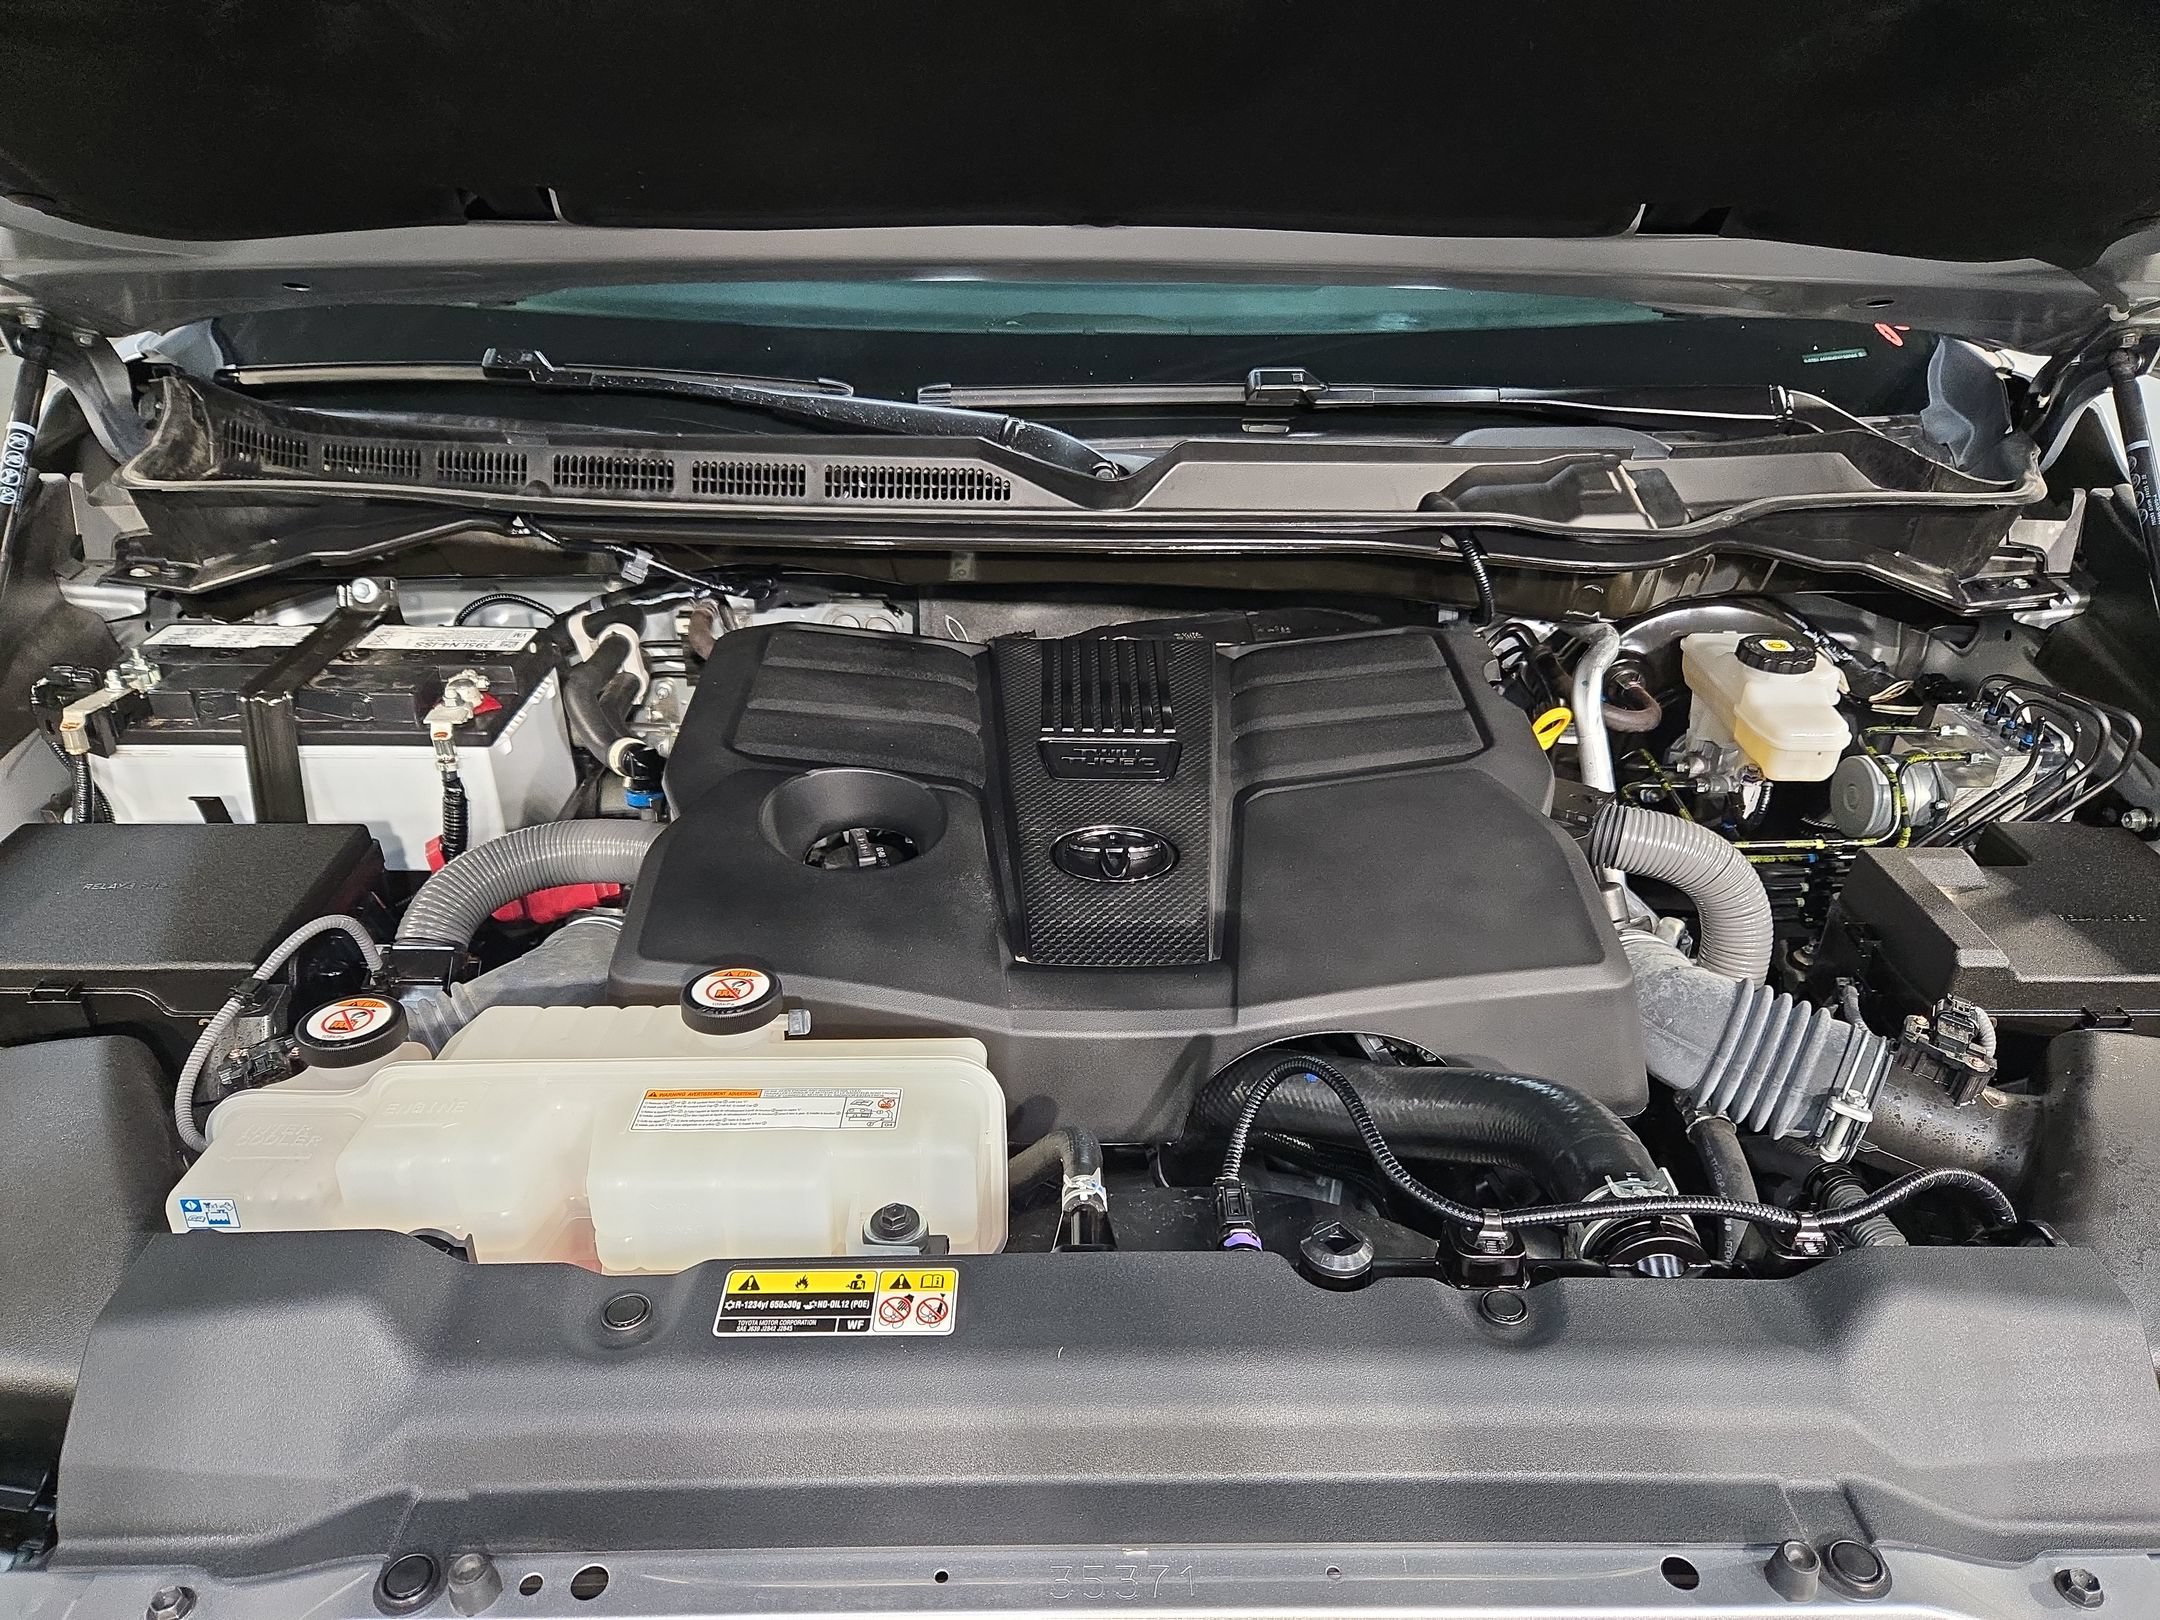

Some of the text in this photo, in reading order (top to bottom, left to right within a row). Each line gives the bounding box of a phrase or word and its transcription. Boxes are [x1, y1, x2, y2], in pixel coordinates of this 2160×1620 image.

[735, 1299, 870, 1310] R-1234yf 650±30g ND-OIL12 (POE)
[847, 1319, 865, 1330] WF
[1048, 1565, 1197, 1600] 35371
